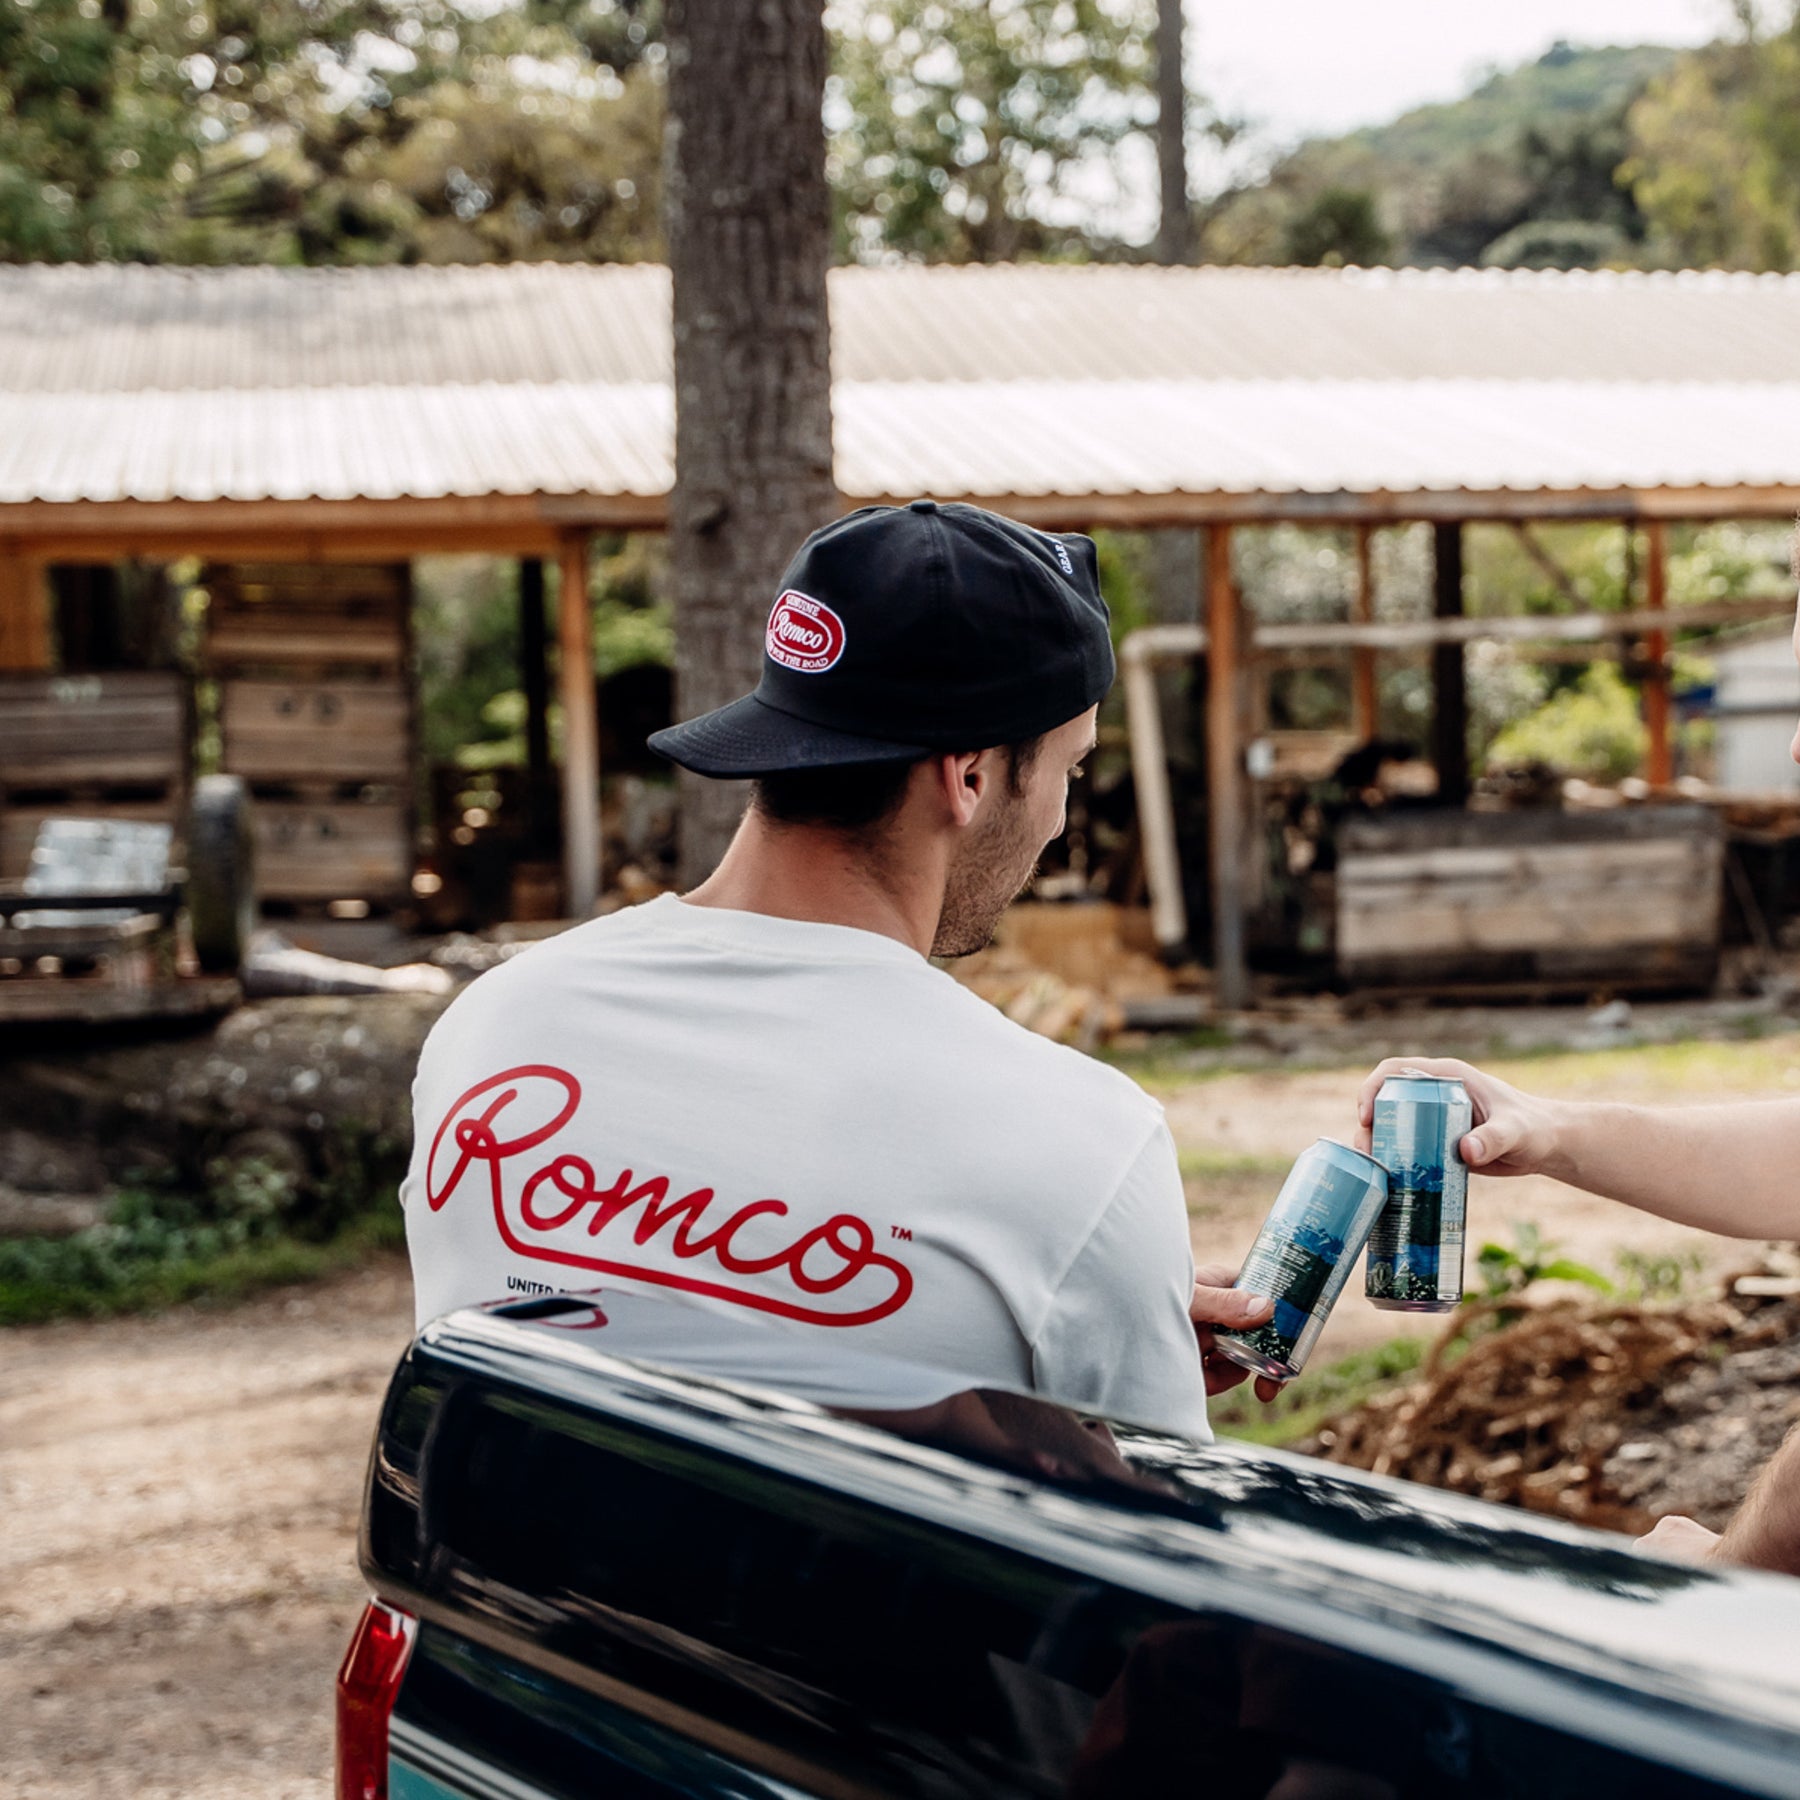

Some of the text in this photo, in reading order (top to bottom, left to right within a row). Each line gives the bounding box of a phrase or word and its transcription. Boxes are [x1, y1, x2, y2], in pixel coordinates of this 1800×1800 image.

[774, 611, 823, 649] Romco
[785, 653, 801, 667] THE
[801, 657, 829, 669] ROAD
[426, 1064, 914, 1327] Romco
[507, 1275, 554, 1295] UNITED
